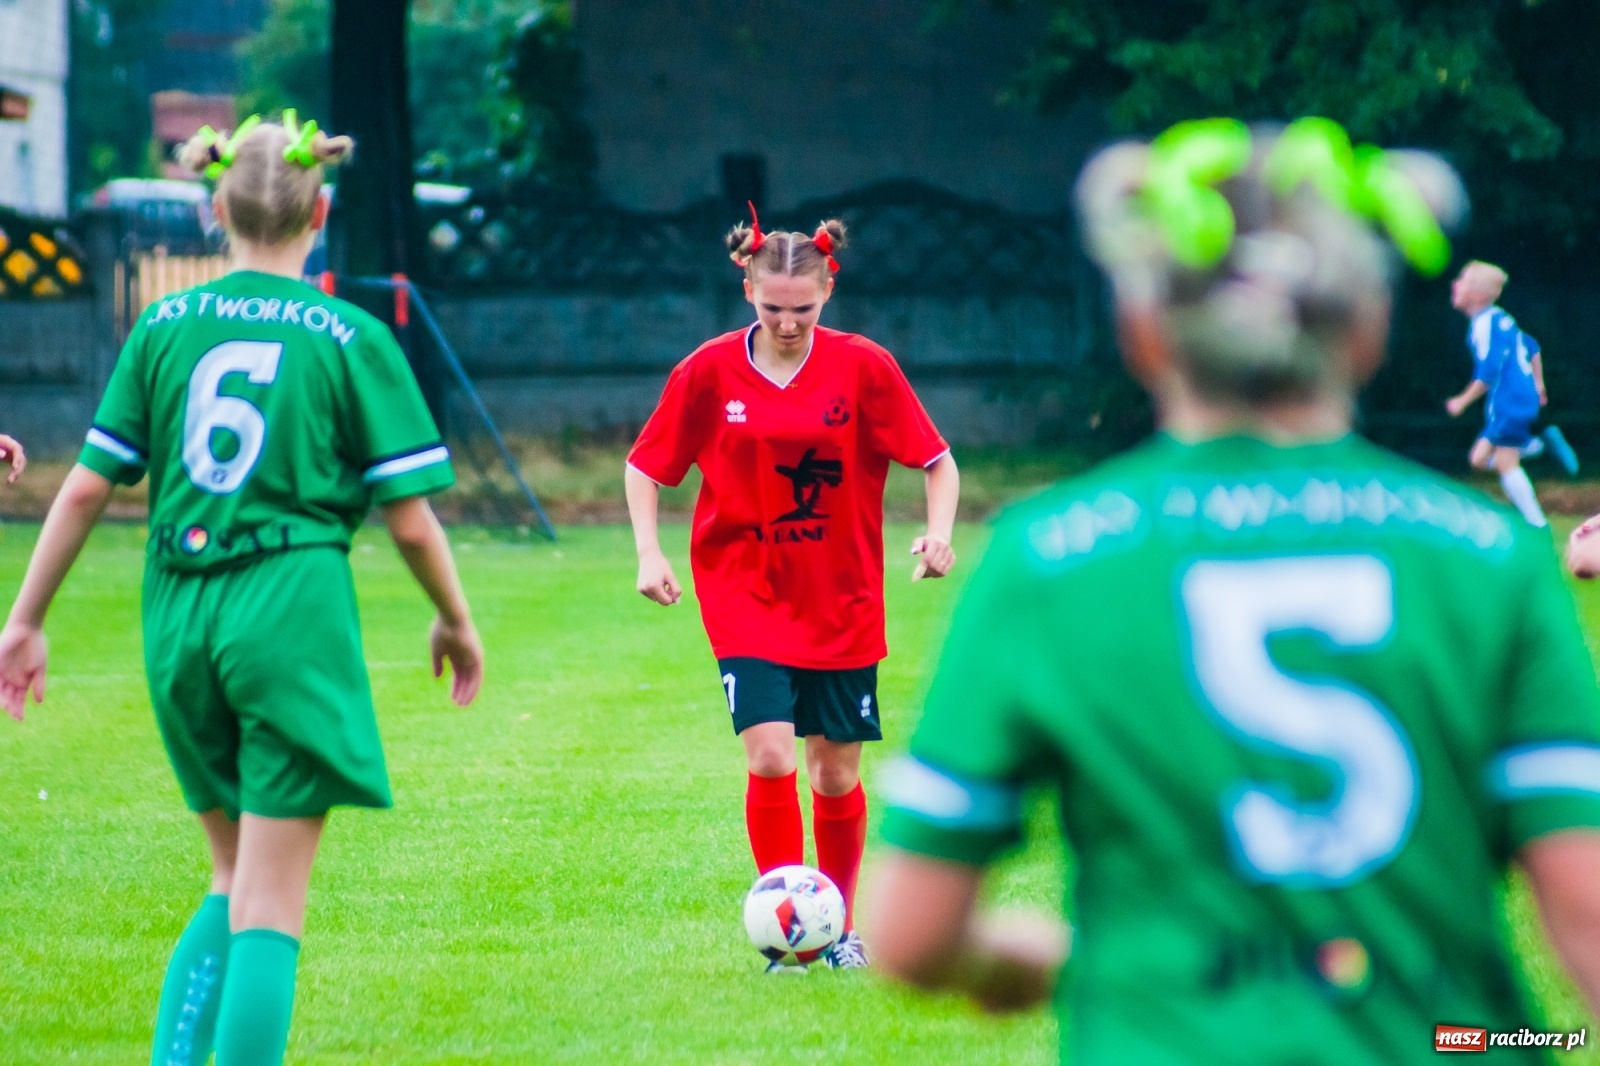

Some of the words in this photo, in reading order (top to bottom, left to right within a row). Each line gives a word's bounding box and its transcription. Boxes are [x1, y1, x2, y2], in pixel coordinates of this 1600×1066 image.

[198, 292, 356, 346] TWORKÓW
[182, 339, 284, 493] 6
[1180, 553, 1416, 880] 5
